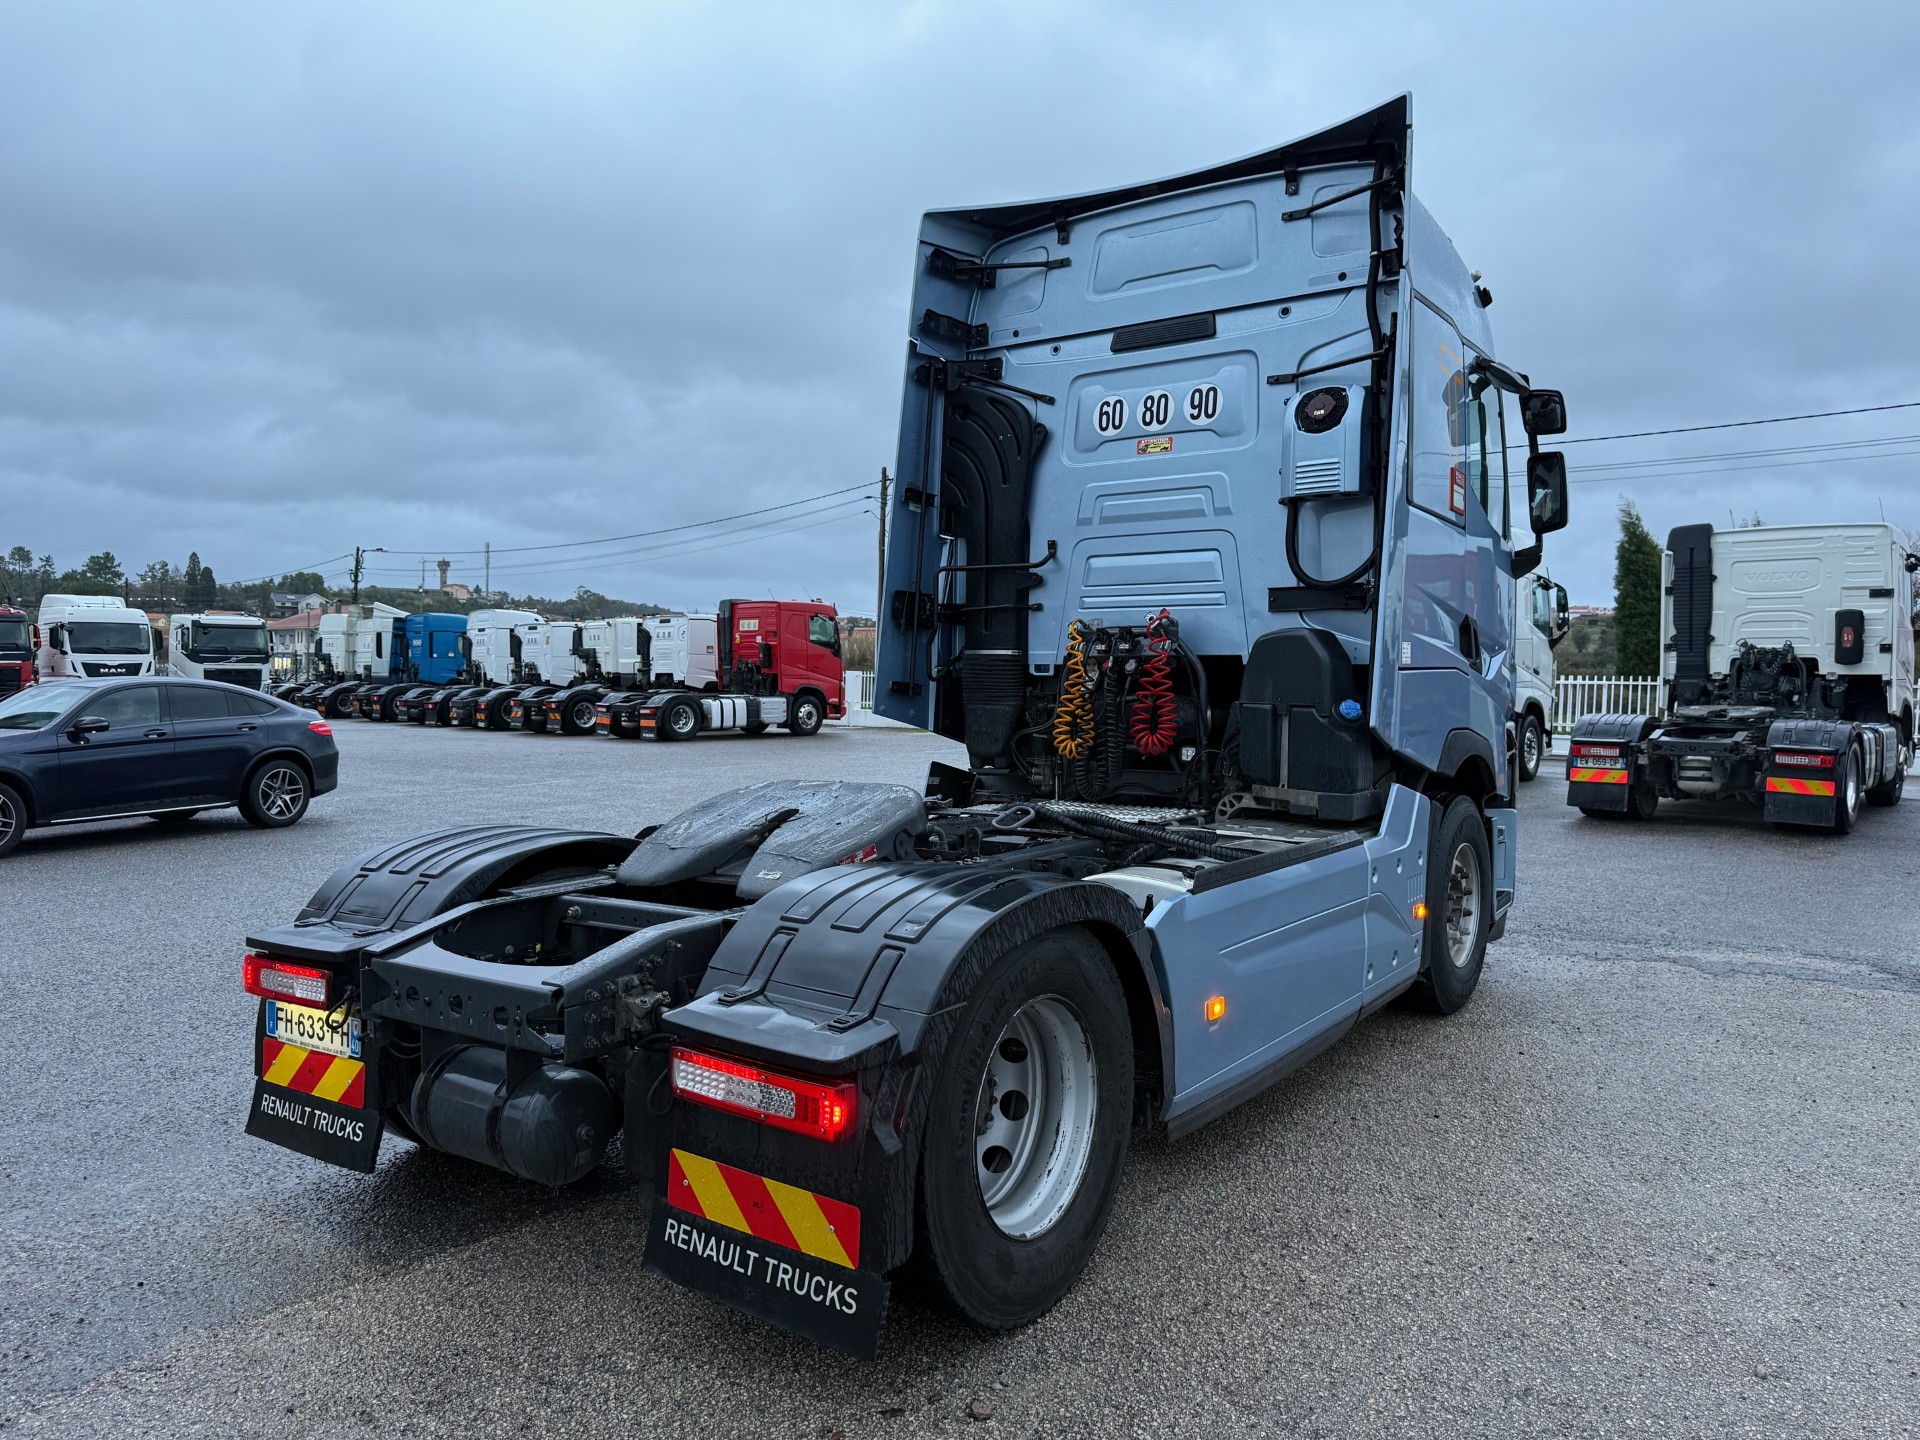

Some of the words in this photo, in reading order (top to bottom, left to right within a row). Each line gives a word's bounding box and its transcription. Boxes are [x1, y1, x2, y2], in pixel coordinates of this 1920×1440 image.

[1098, 398, 1124, 432] 60
[1141, 393, 1169, 427] 80
[1189, 386, 1218, 421] 90
[1742, 570, 1810, 582] VOLVO
[1579, 757, 1620, 767] EW-059-DP
[275, 1006, 350, 1049] FH-633-FH
[350, 1038, 359, 1053] 40
[260, 1093, 312, 1126] RENAULT
[313, 1109, 364, 1142] TRUCKS
[664, 1217, 760, 1277] RENAULT
[764, 1256, 858, 1315] TRUCKS
